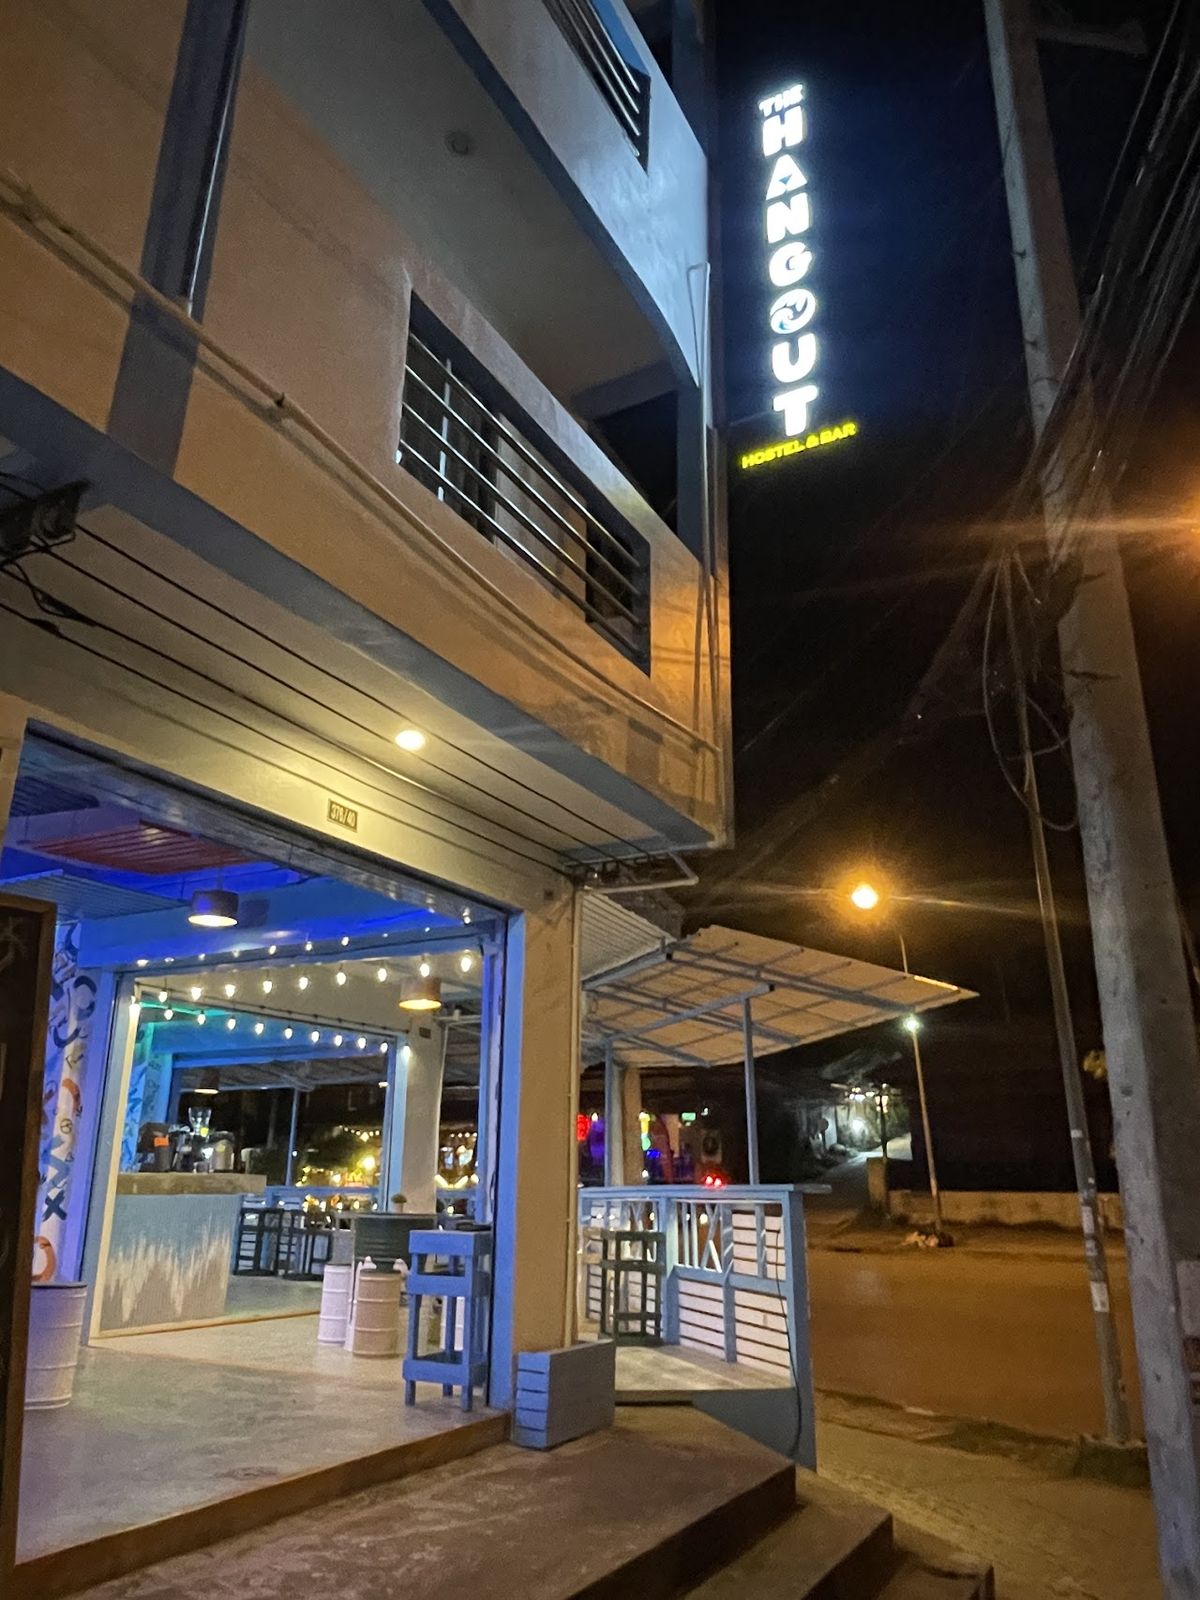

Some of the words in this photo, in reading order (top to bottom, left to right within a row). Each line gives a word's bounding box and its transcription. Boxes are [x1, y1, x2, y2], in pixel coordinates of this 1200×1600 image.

[758, 84, 804, 118] THE
[762, 105, 819, 437] HANGOUT
[741, 439, 806, 469] HOSTEL
[806, 434, 820, 449] &
[820, 422, 857, 445] BAR
